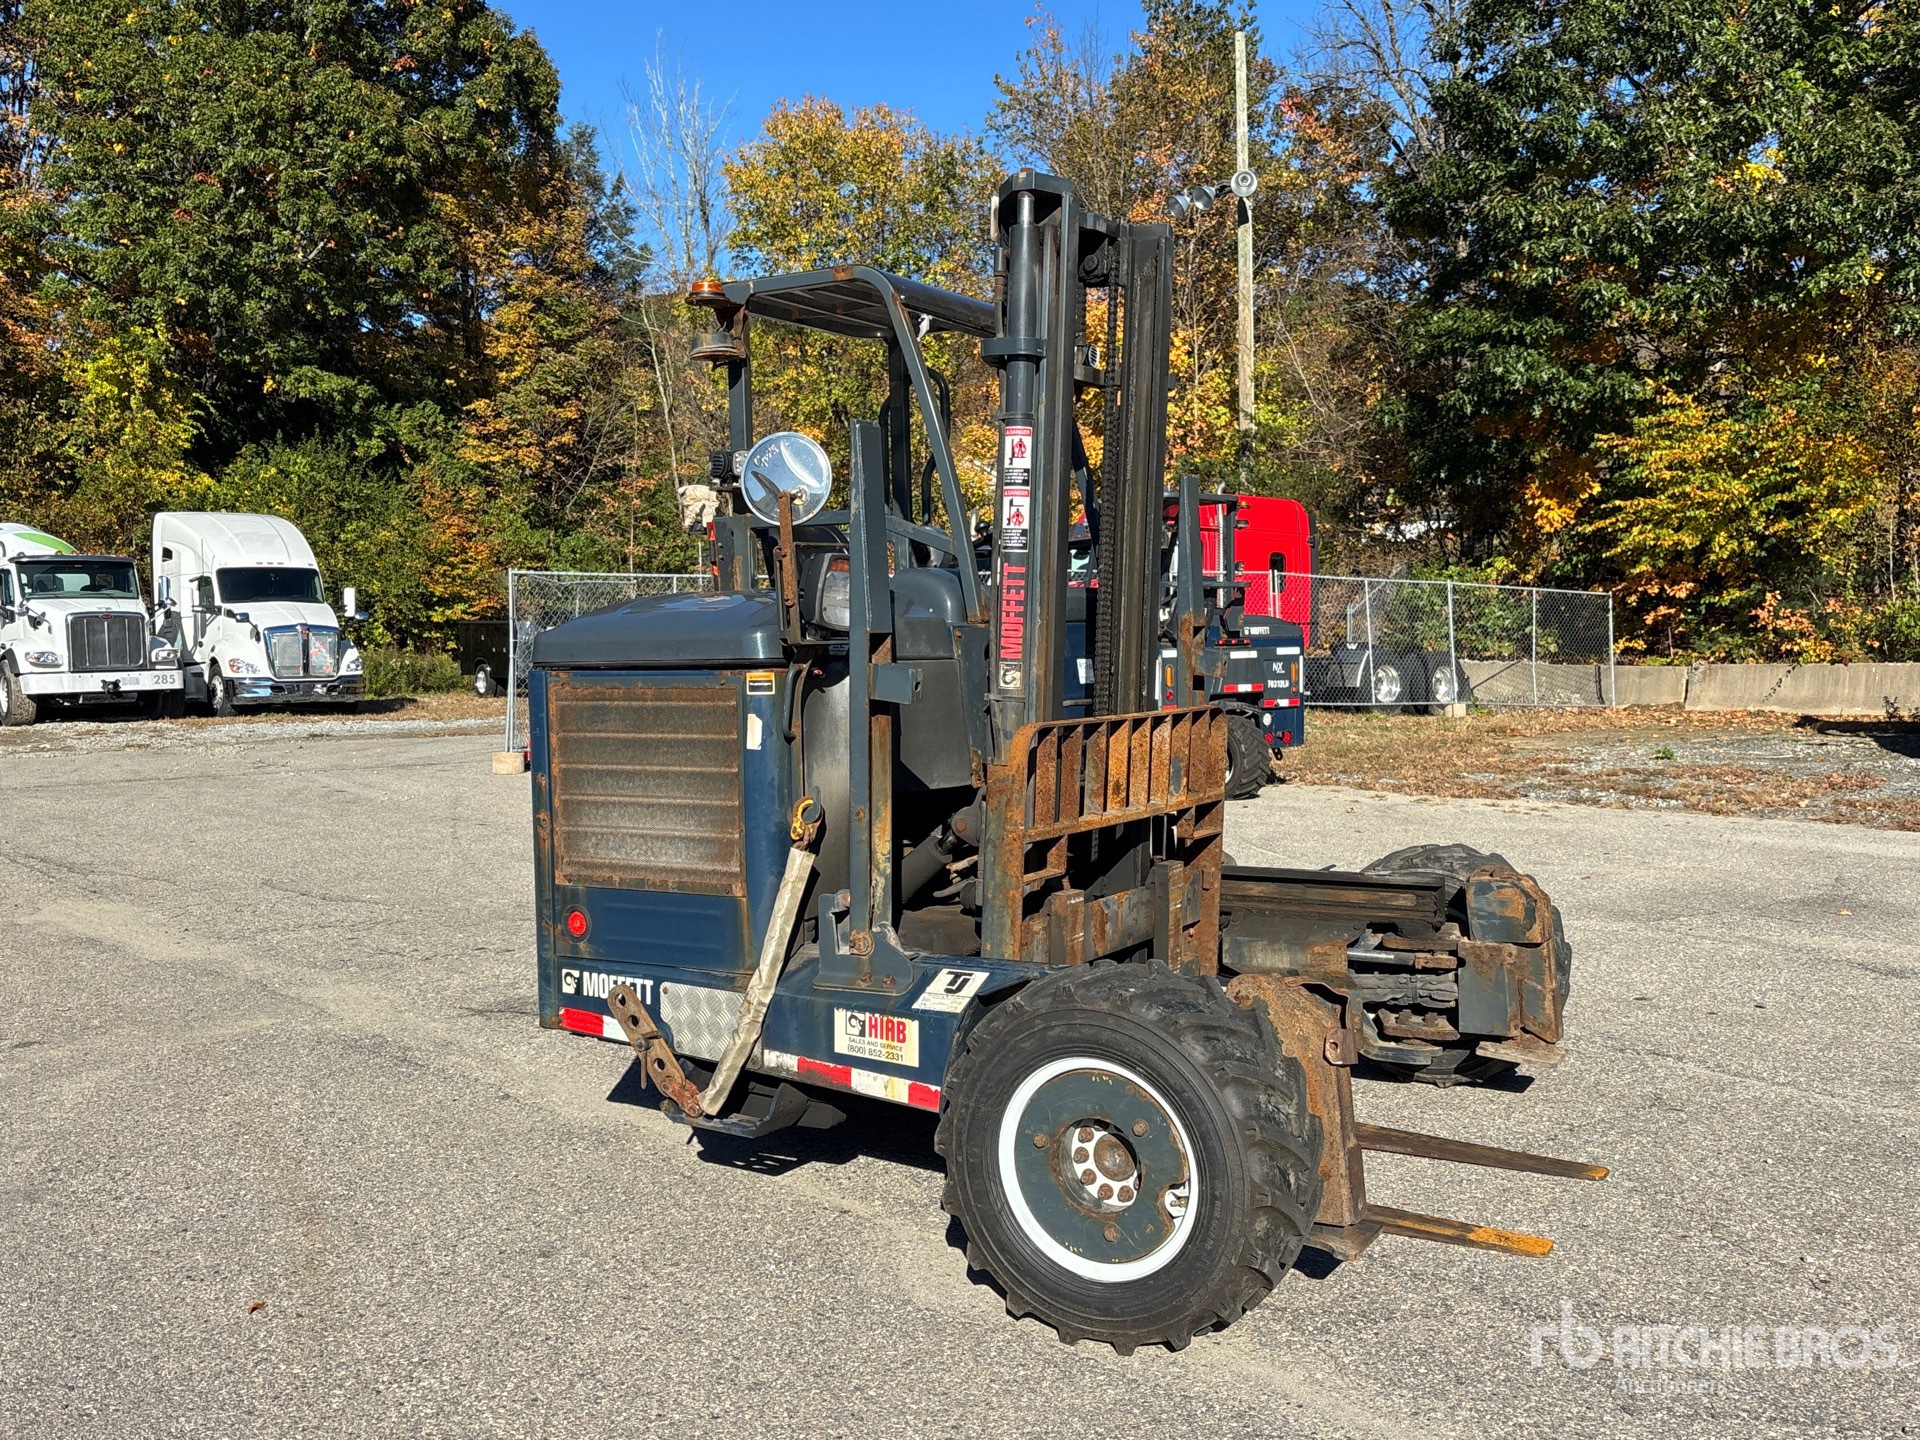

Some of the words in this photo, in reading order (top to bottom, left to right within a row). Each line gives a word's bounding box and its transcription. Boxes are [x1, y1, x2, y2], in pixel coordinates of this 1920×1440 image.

[1000, 562, 1027, 659] MOFFETT
[153, 674, 176, 685] 285
[868, 1015, 907, 1044] HIAB
[847, 1044, 867, 1056] (800)
[868, 1048, 904, 1062] 852-2331
[848, 1036, 866, 1046] SALES
[879, 1042, 904, 1053] SERVICE
